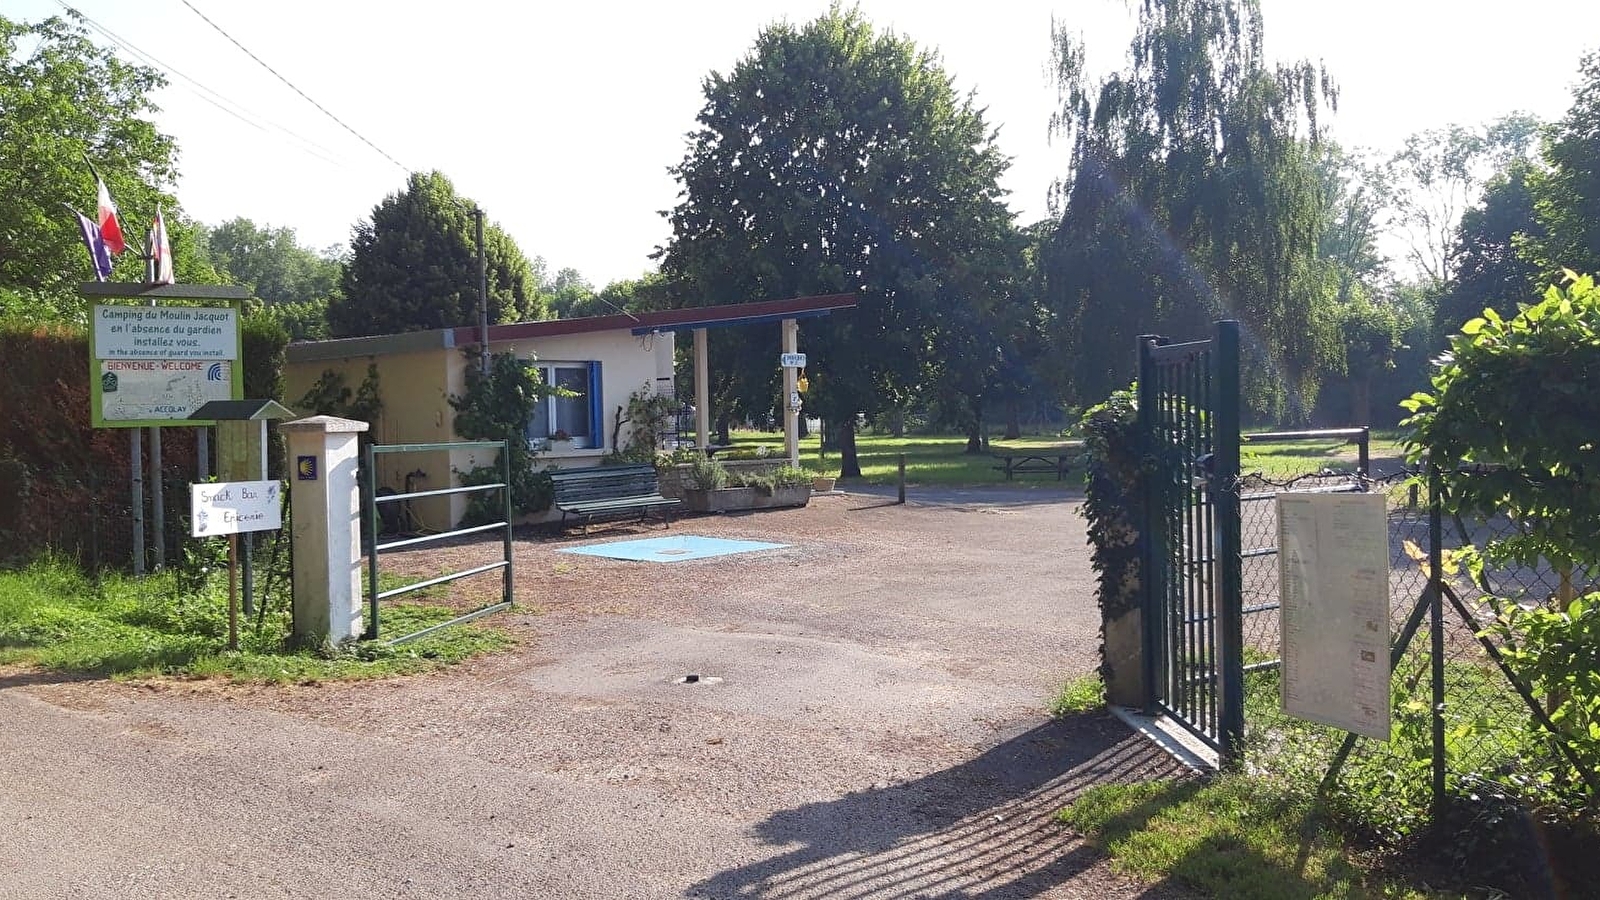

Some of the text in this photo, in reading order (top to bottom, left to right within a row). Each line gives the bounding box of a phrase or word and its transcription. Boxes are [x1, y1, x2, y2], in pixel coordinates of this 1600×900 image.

[102, 309, 229, 324] Camping du Moulin Jacquot
[125, 324, 170, 334] l'absence
[173, 326, 184, 334] du
[187, 326, 222, 336] gardien
[134, 338, 173, 346] installez
[201, 488, 258, 502] Snack Bar
